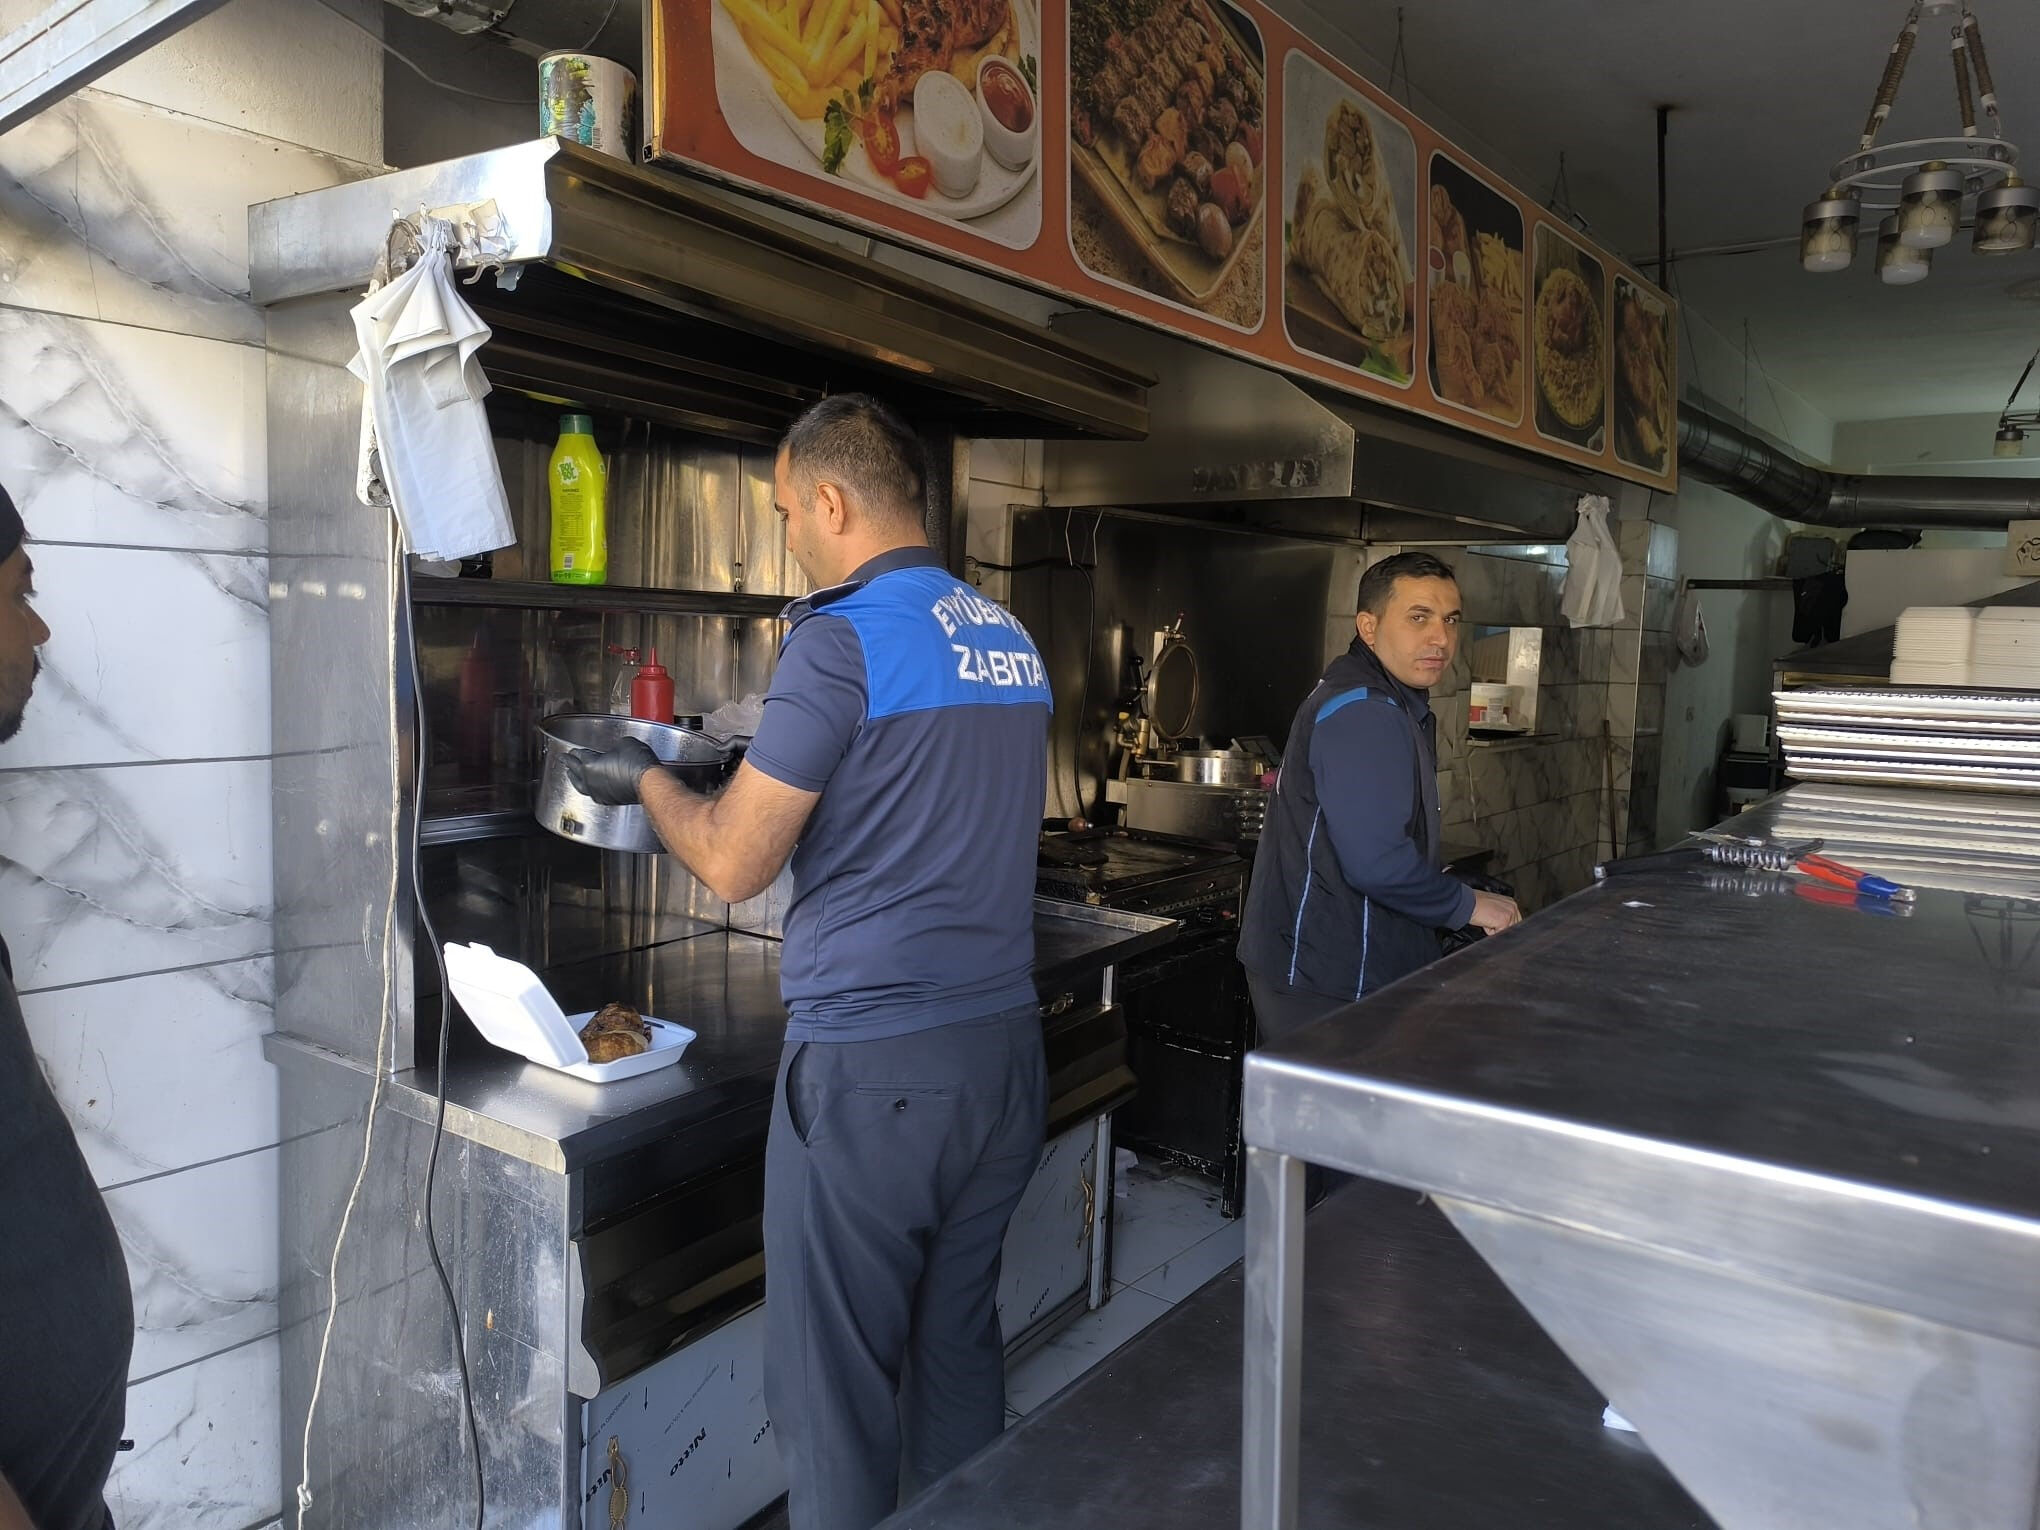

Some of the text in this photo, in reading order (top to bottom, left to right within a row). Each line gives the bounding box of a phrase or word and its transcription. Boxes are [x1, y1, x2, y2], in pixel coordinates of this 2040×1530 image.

[951, 643, 1047, 690] ZABITA
[1080, 1143, 1094, 1168] Nitt
[669, 1427, 707, 1477] Nitto
